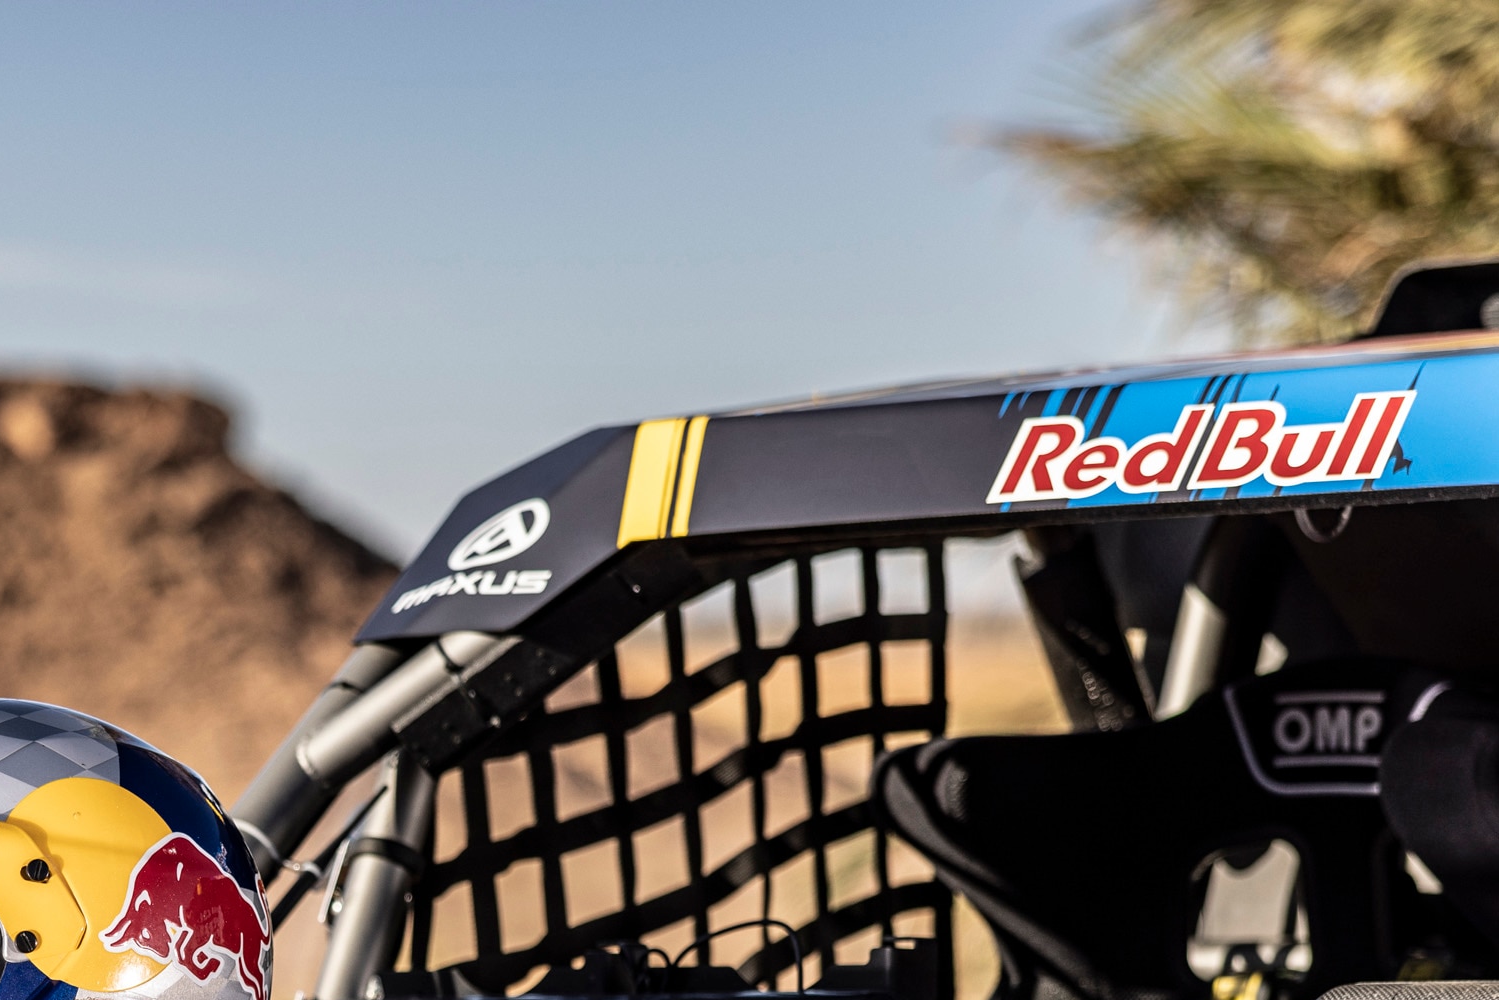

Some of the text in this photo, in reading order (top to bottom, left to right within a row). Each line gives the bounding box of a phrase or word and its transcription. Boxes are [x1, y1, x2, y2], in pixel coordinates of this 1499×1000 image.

[990, 391, 1414, 502] Red Bull
[392, 570, 551, 614] MAXUS
[1274, 705, 1382, 752] OMP
